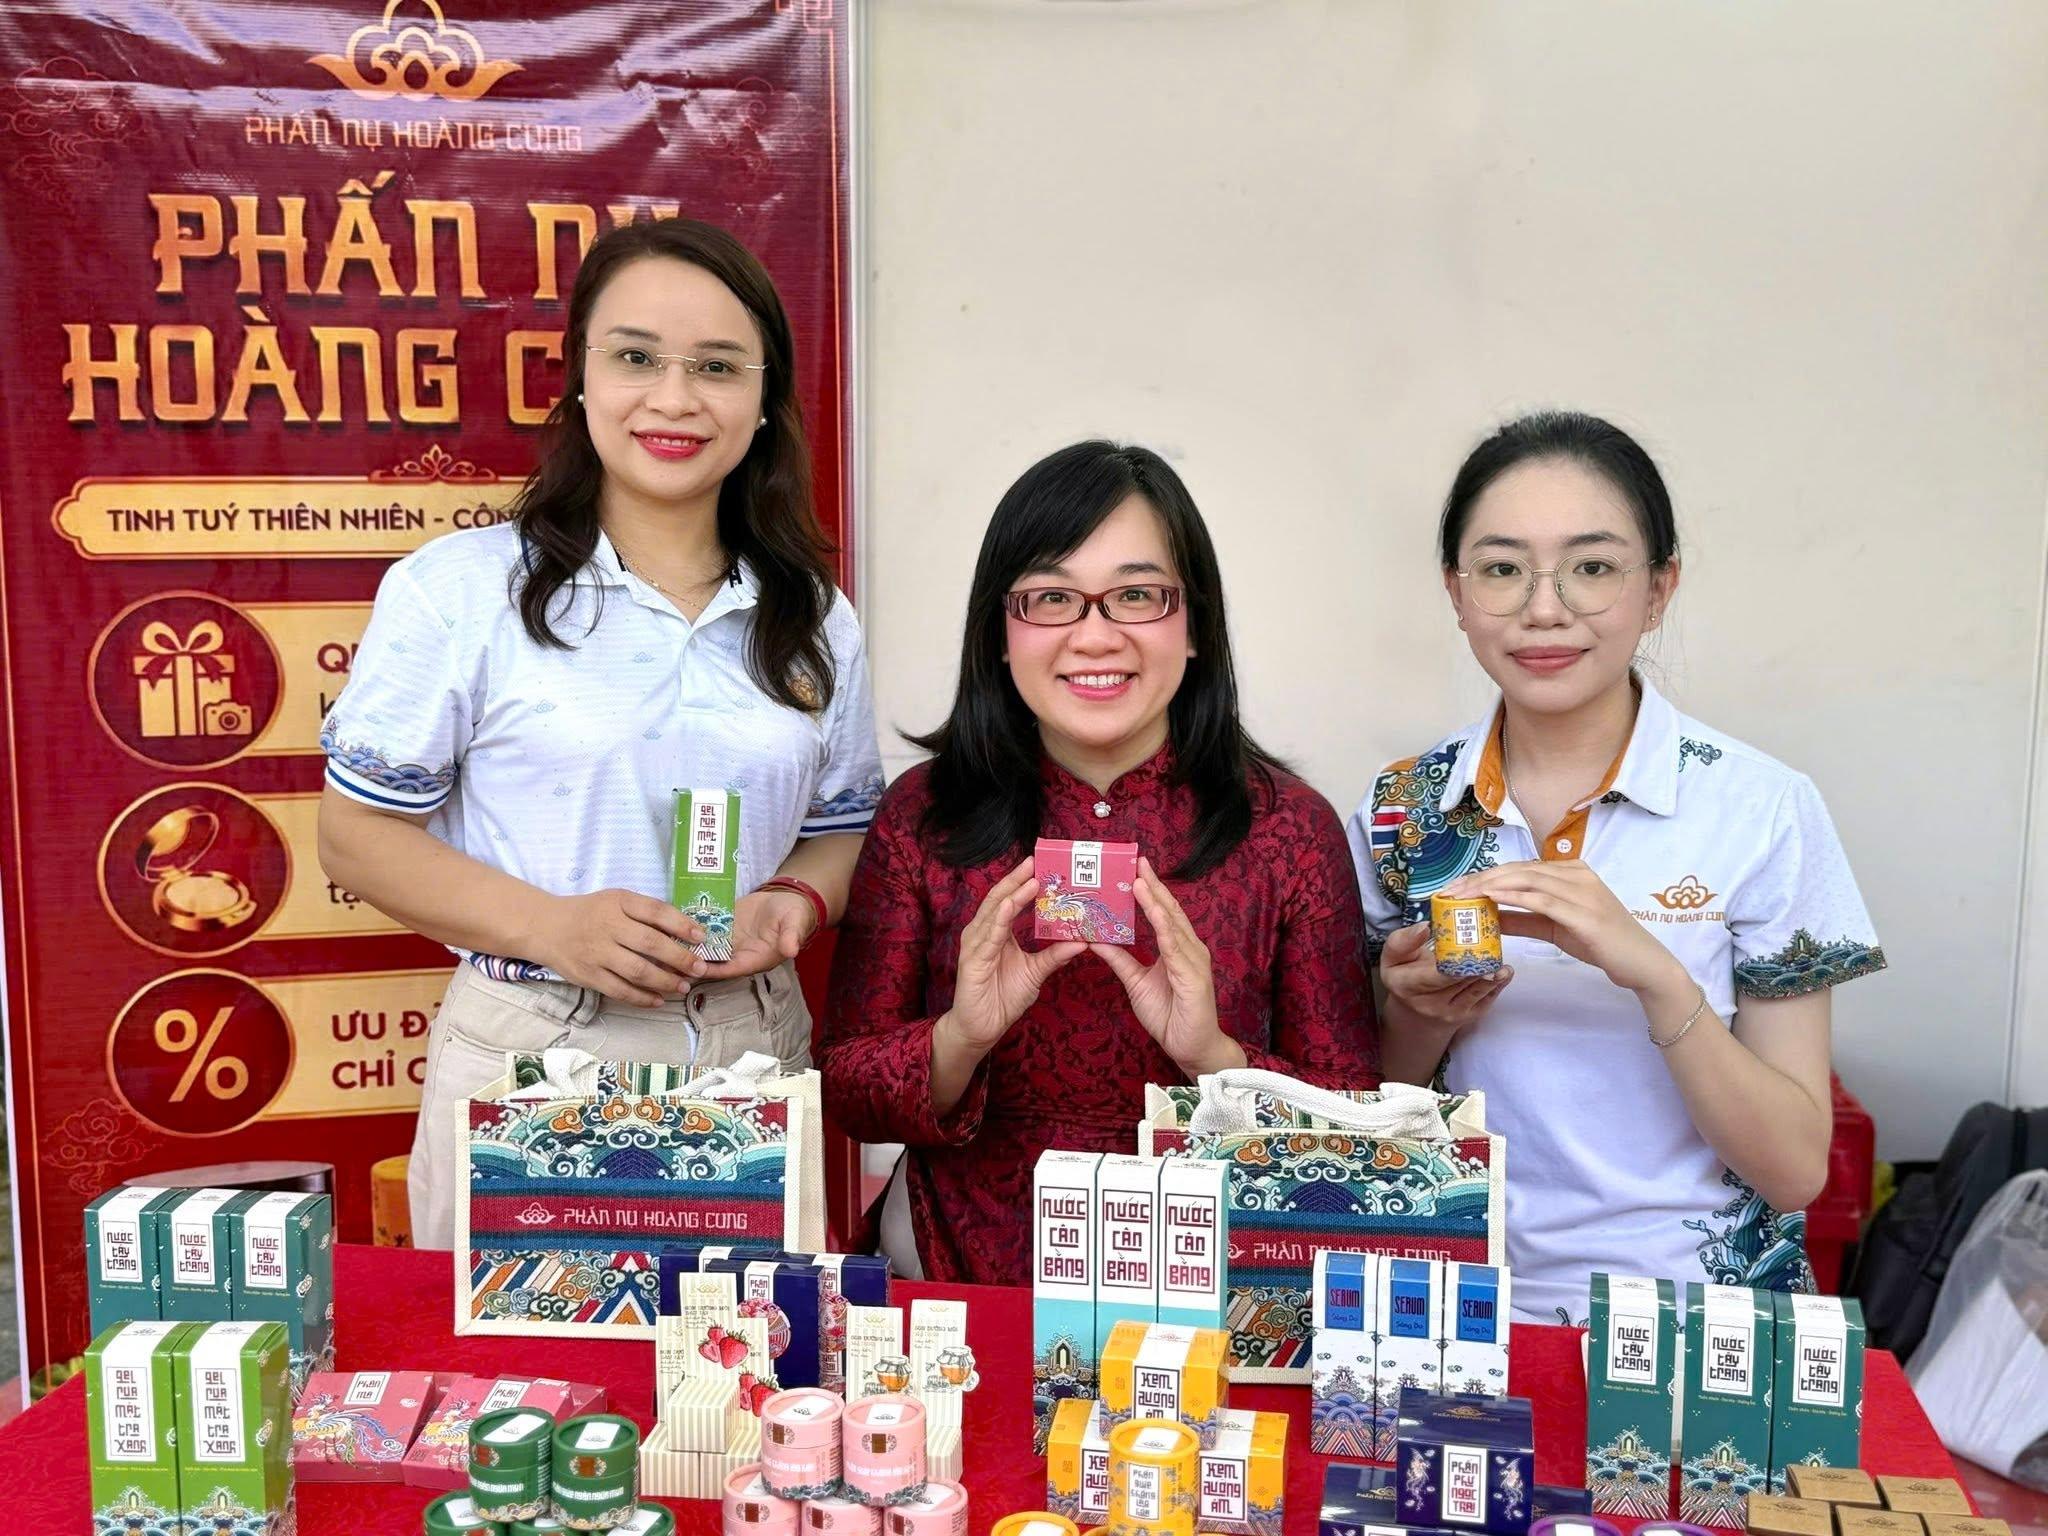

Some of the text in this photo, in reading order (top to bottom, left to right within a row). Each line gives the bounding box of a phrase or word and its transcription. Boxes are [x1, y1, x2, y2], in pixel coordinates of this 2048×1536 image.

[246, 109, 582, 152] PHẤN NỤ HOÀNG CUNG
[146, 170, 488, 302] PHẤN
[61, 305, 460, 425] HOÀNG
[107, 508, 174, 532] TINH
[183, 502, 239, 532] TUÝ
[249, 502, 329, 532] THIÊN
[340, 501, 425, 532] NHIÊN
[332, 1010, 386, 1042] ƯU
[332, 1049, 395, 1089] CHỈ
[705, 1212, 748, 1230] CUNG
[1330, 1288, 1360, 1308] SERUM
[1394, 1295, 1425, 1316] SERUM
[1462, 1299, 1492, 1320] SERUM
